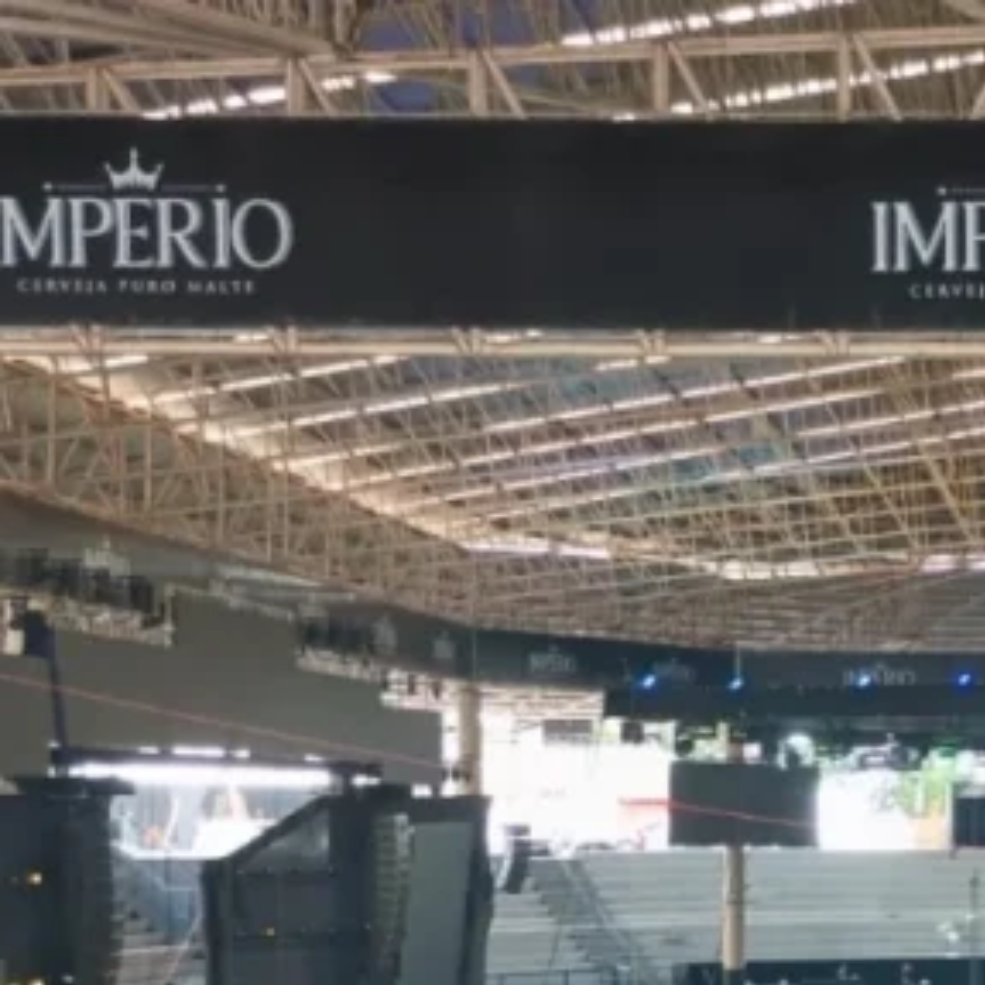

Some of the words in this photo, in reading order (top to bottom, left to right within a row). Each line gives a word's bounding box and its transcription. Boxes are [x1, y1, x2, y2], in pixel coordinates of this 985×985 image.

[0, 195, 293, 269] MPERIO
[15, 276, 108, 294] CERVEJA
[118, 278, 176, 294] PURO
[187, 279, 255, 295] MALTE
